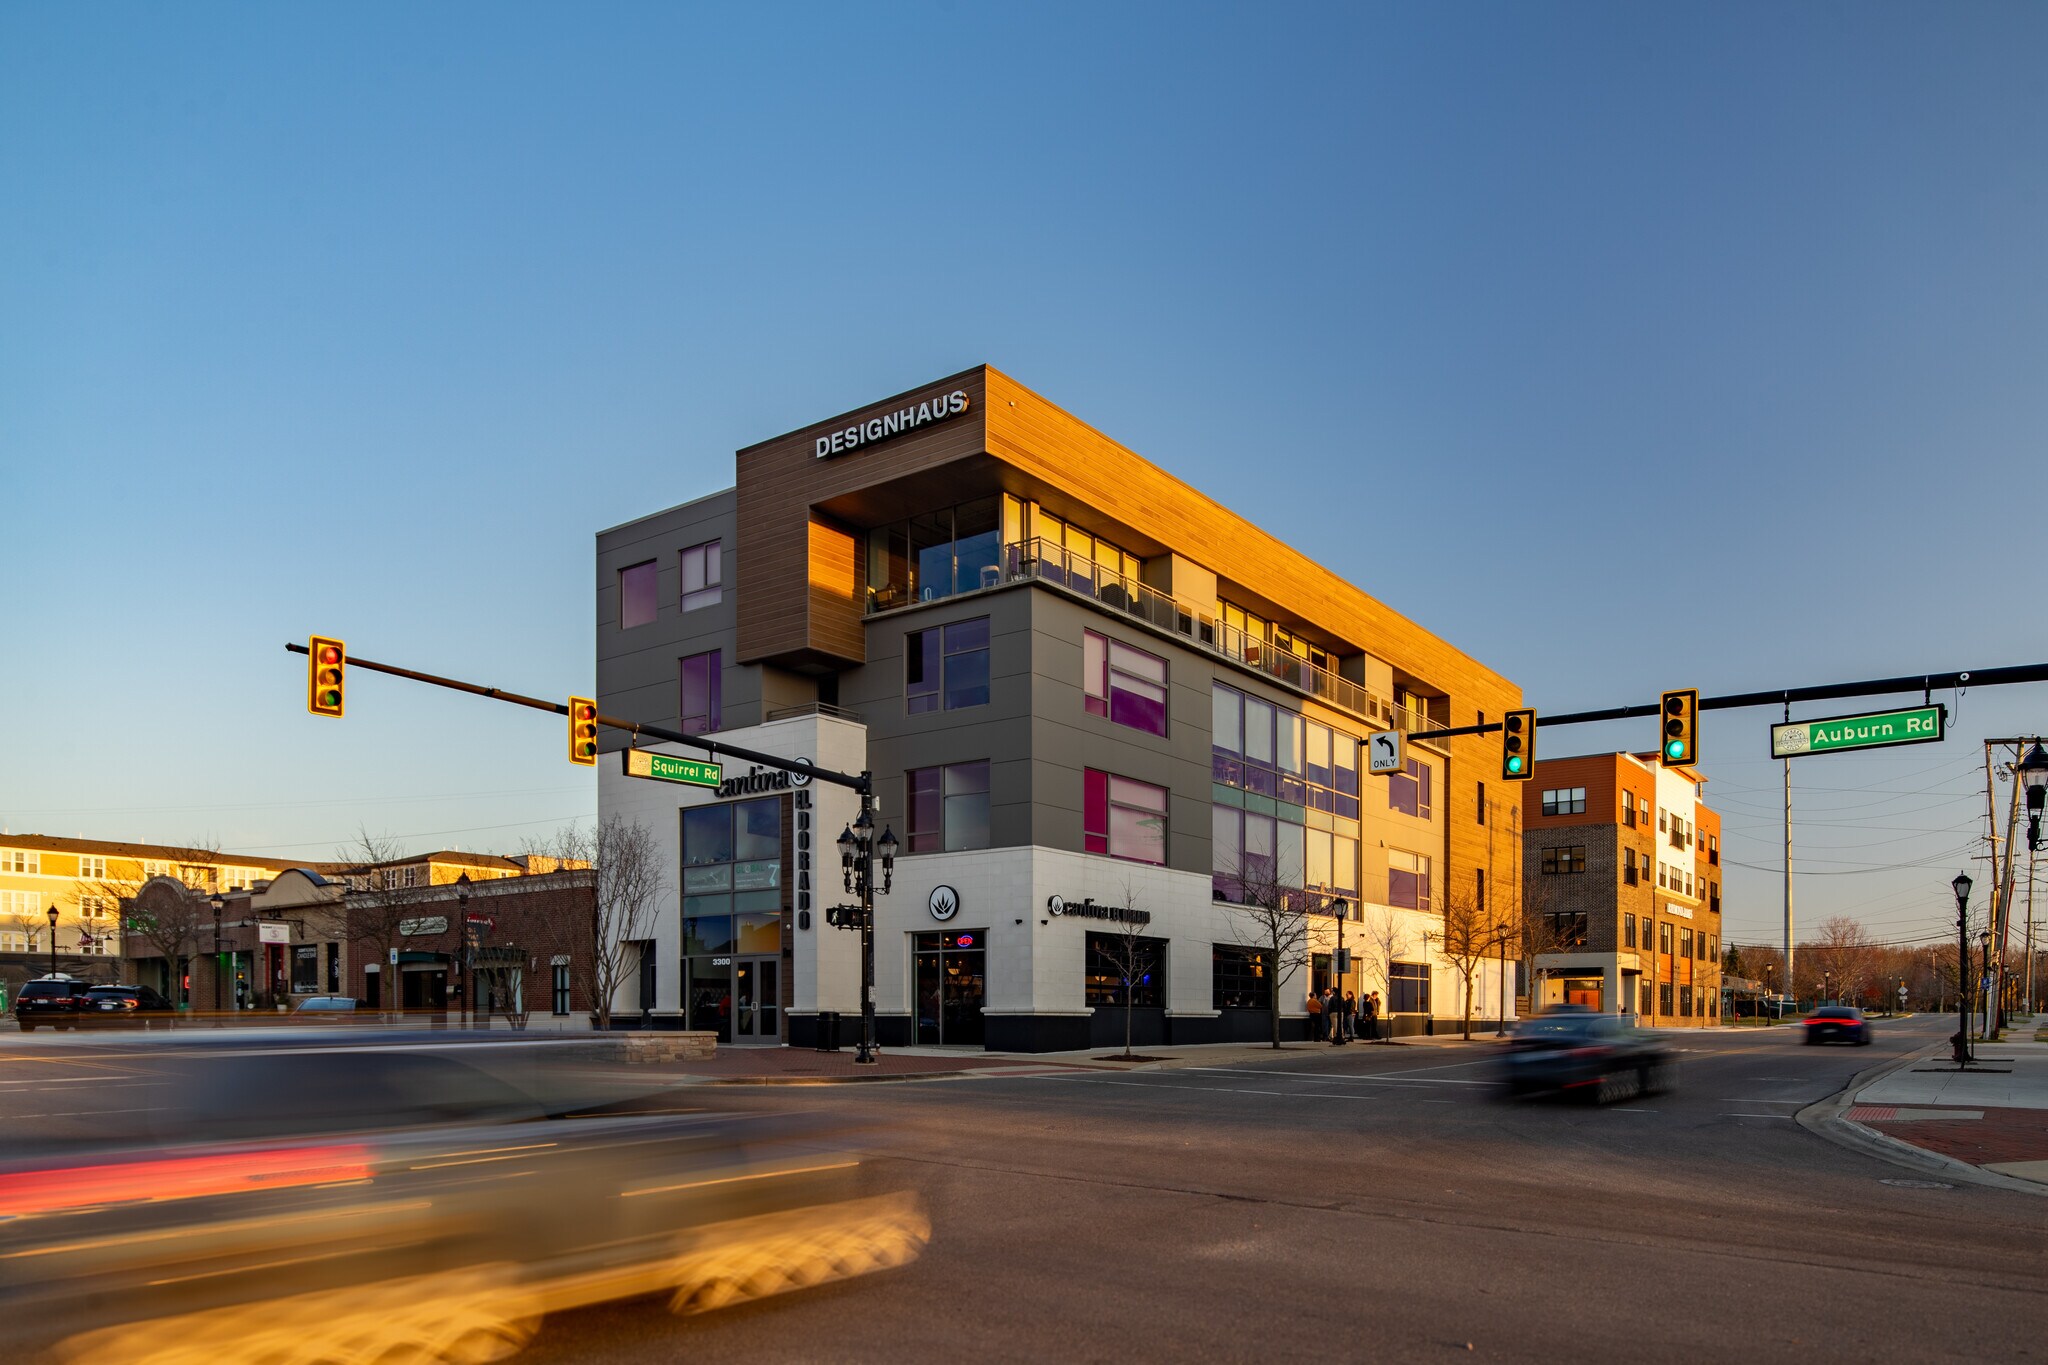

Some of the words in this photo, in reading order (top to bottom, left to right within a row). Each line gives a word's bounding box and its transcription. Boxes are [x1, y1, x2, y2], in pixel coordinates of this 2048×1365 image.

[816, 390, 968, 459] DESIGNHAUS
[1814, 724, 1893, 743] Auburn
[1907, 717, 1933, 733] Rd
[653, 760, 699, 777] Squirrel
[704, 768, 718, 780] Rd
[1373, 758, 1396, 768] ONLY
[795, 789, 812, 810] EL
[736, 863, 765, 874] GLOBAL
[797, 811, 811, 930] DORADO
[1122, 908, 1150, 924] DORADO
[957, 937, 973, 945] OPEN
[712, 958, 731, 966] 3300
